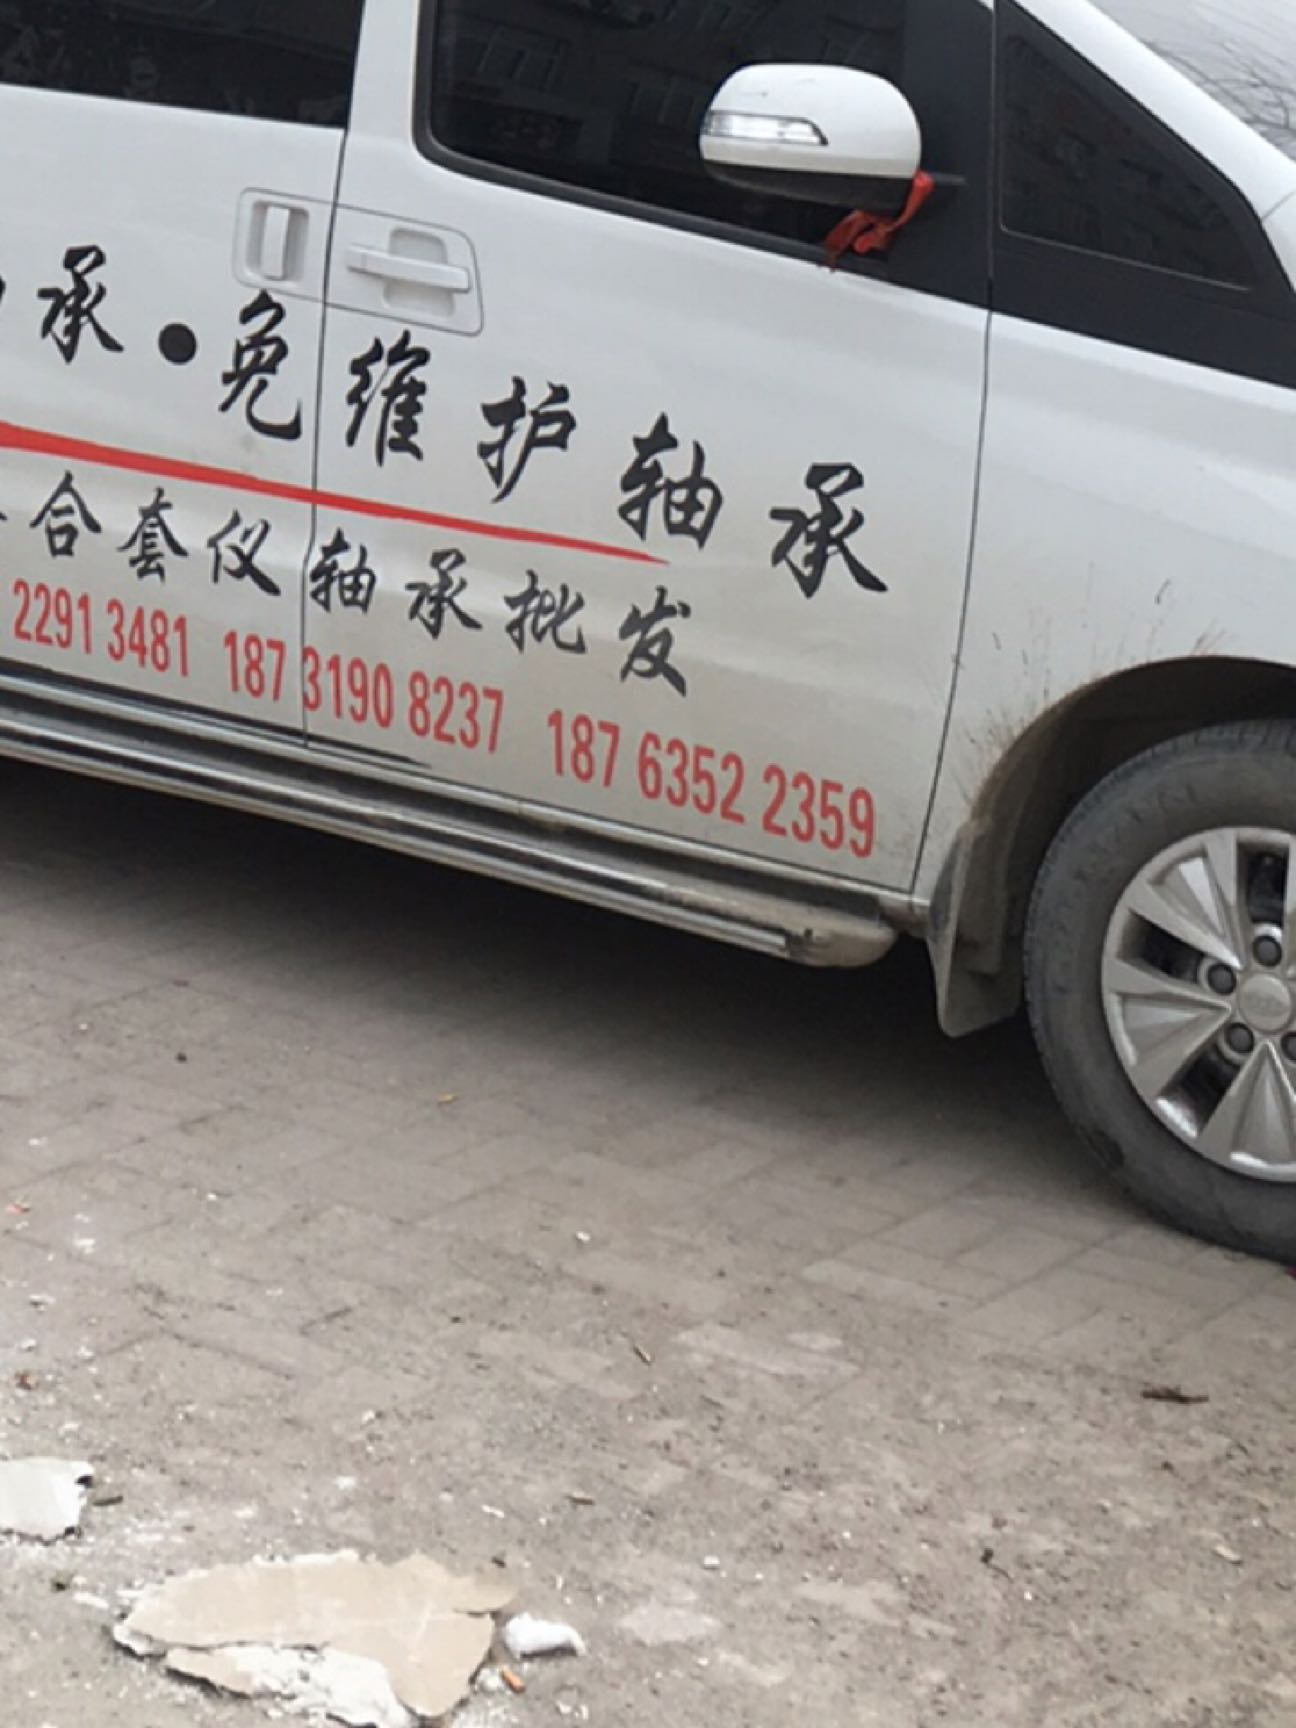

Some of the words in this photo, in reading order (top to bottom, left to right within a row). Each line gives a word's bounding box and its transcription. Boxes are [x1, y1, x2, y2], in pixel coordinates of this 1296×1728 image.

[13, 578, 92, 655] 2291
[106, 597, 189, 678] 3481
[223, 629, 286, 703] 187
[302, 645, 394, 729] 3190
[407, 670, 504, 753] 8237
[547, 708, 621, 788] 187
[637, 730, 746, 825] 6352
[761, 763, 875, 859] 2359
